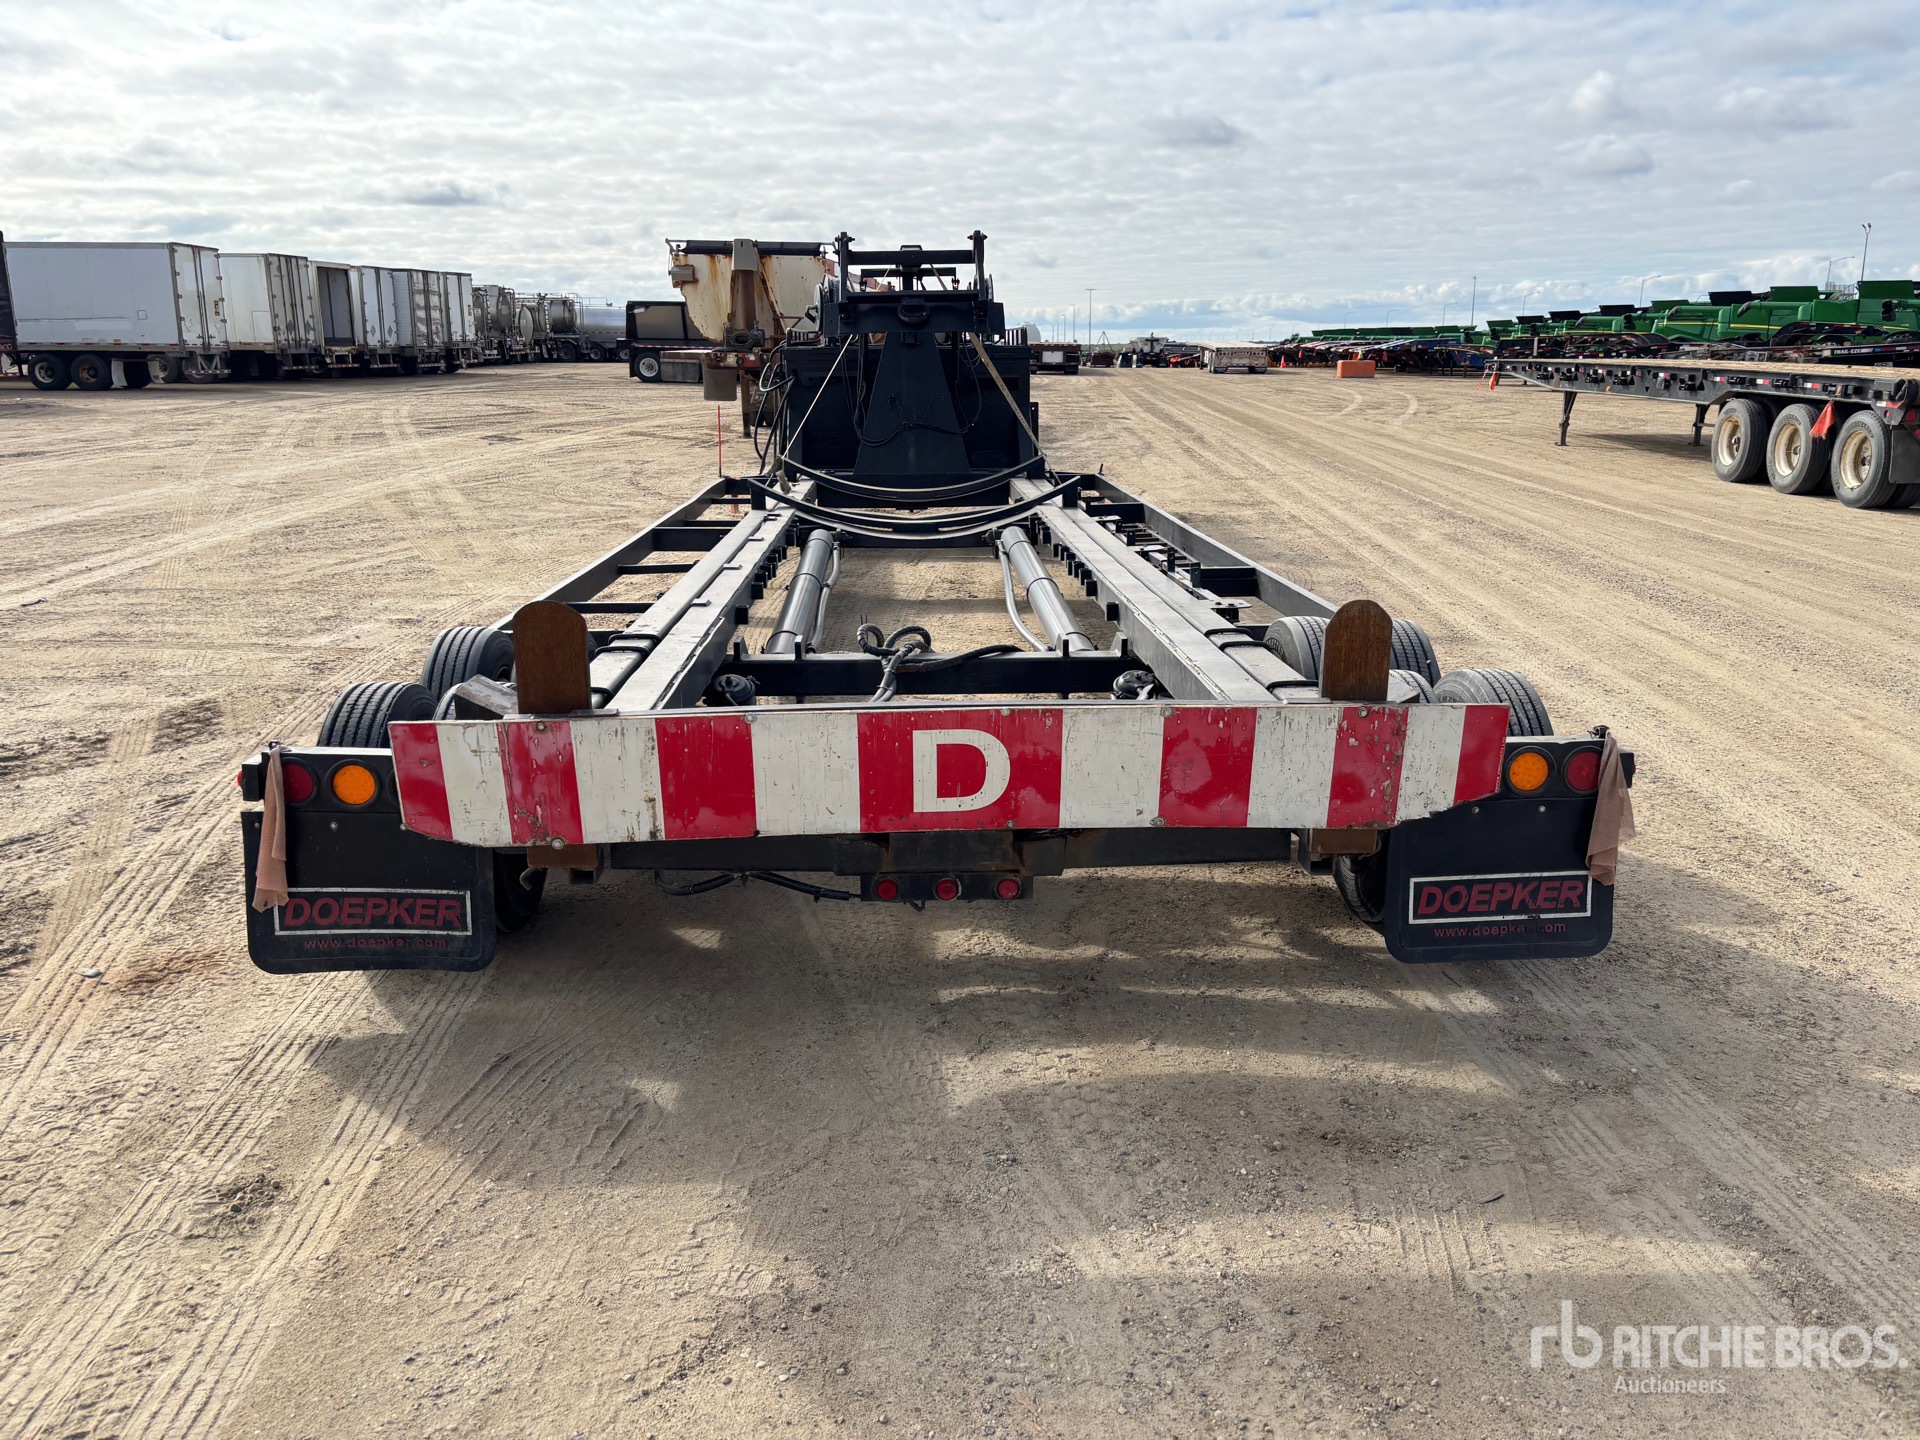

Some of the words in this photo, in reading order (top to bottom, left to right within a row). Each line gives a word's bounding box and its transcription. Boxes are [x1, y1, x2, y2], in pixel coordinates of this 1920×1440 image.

[912, 728, 1011, 813] D
[284, 896, 463, 927] DOEPKER
[1417, 880, 1585, 915] DOEPKER
[304, 936, 448, 949] www.doepke.com
[1433, 922, 1567, 938] www.doepkeom
